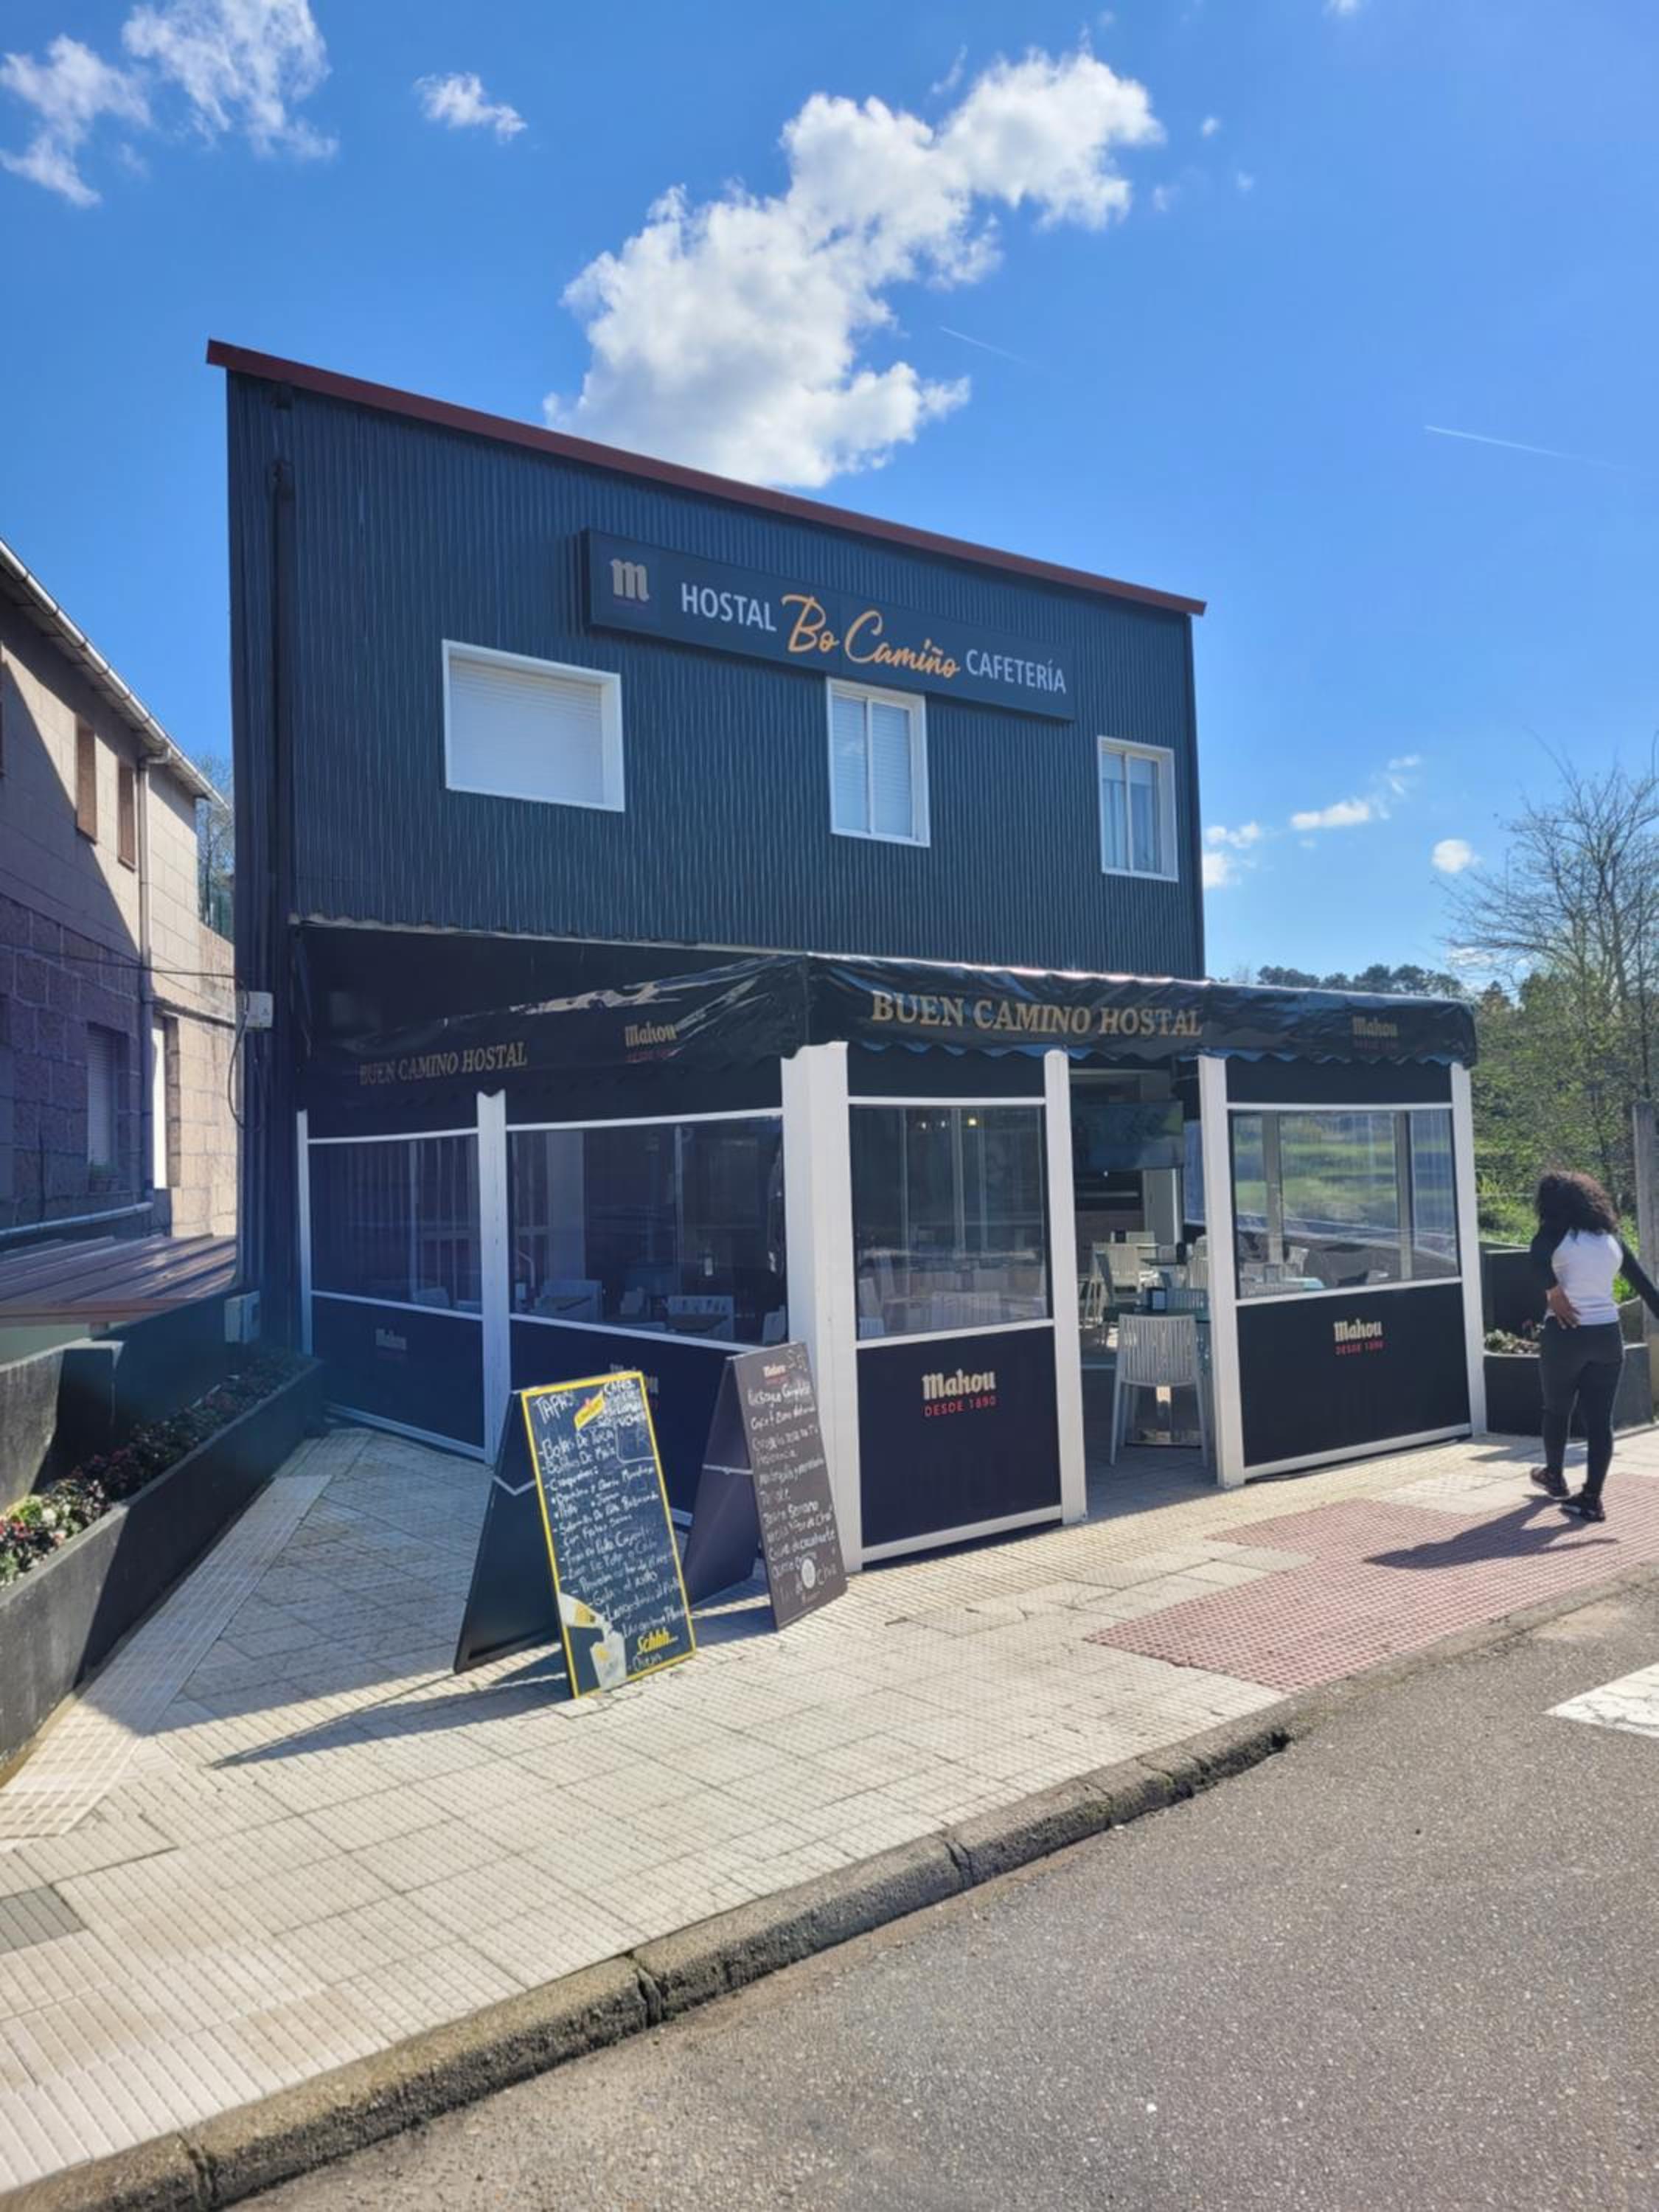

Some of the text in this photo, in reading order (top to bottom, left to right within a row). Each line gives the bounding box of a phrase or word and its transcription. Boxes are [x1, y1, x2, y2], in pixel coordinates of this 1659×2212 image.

[681, 582, 1067, 695] HOSTAL Bo Camiño CAFETERÍA
[870, 991, 1203, 1037] BUEN CAMINO HOSTAL
[359, 1041, 529, 1085] BUEN CAMINO HOSTAL
[1332, 1318, 1382, 1342] Mahou
[921, 1368, 996, 1400] Mahou
[924, 1399, 964, 1417] DESDE
